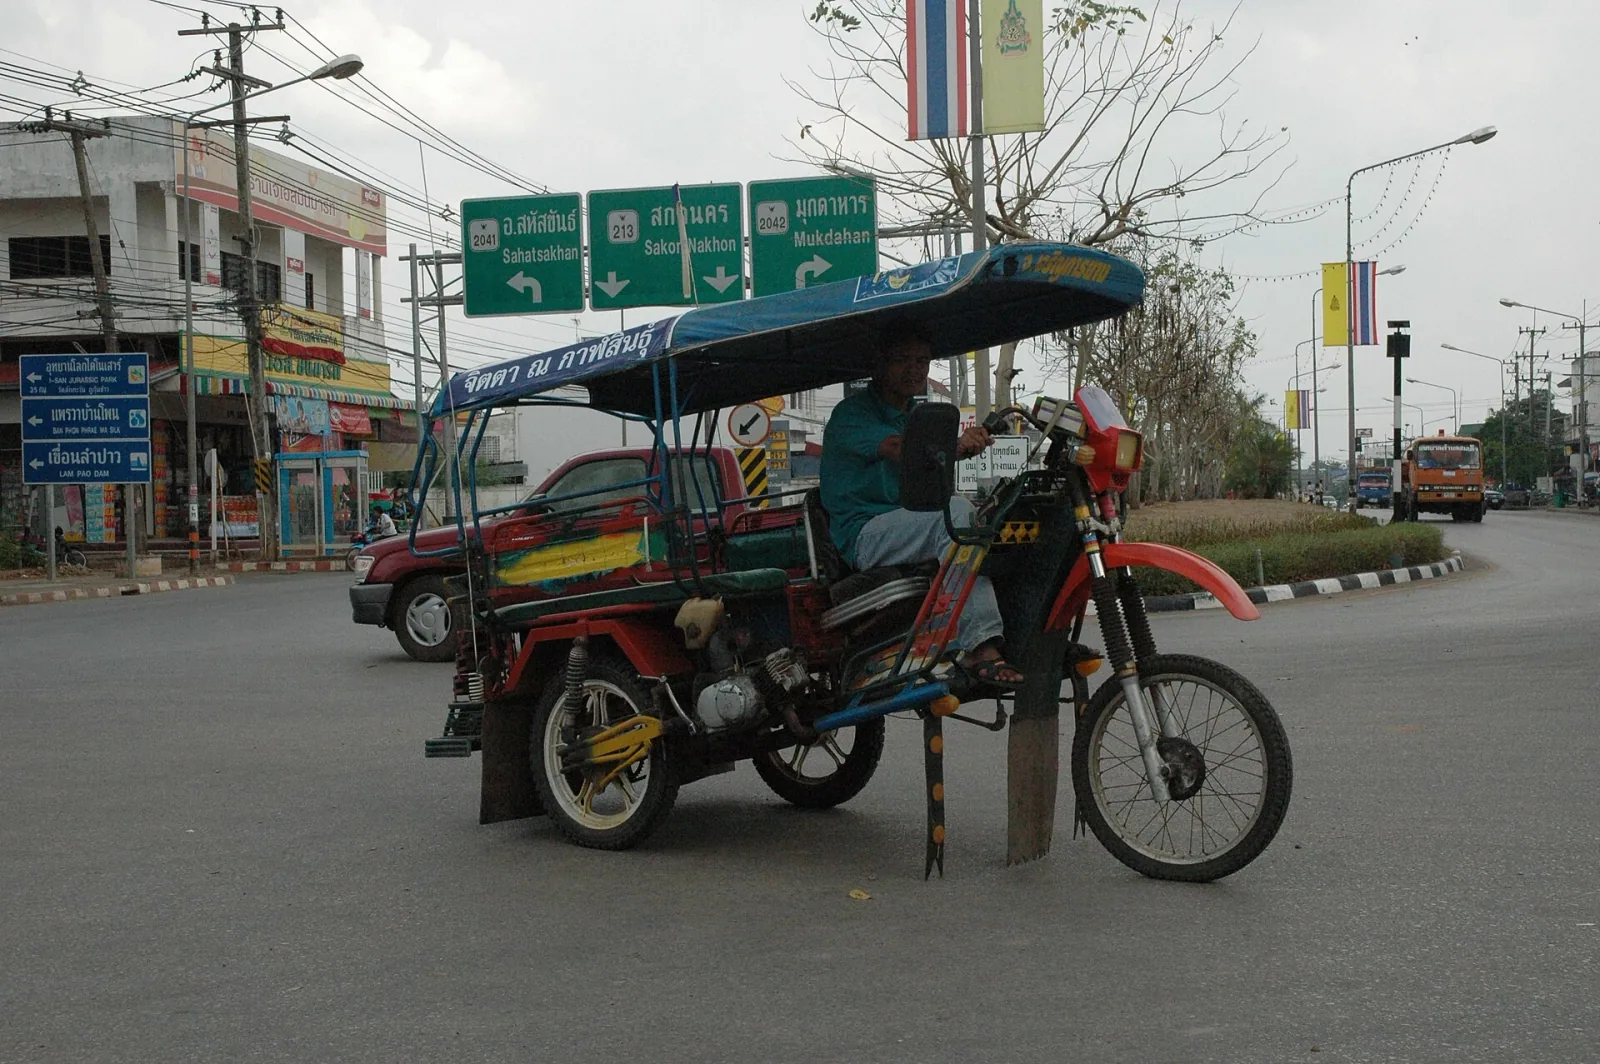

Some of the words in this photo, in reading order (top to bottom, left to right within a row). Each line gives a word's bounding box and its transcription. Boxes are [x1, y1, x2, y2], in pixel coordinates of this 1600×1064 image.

[796, 194, 867, 224] มุกดาหาร
[503, 209, 577, 236] อ.สหัสขันธ์
[759, 216, 787, 230] 2042
[473, 234, 497, 247] 2041
[612, 225, 635, 239] 213
[794, 229, 871, 248] Mukdahan
[502, 246, 579, 264] Sahatsakhan
[644, 239, 682, 256] Sakon
[687, 236, 736, 254] Nakhon
[46, 358, 122, 375] อุทยานโลกไดโนเสาร์
[464, 366, 519, 394] จิตตา
[526, 357, 553, 379] ณ
[557, 322, 656, 371] กาฬสินธุ์
[69, 376, 99, 384] JURASSIC
[51, 403, 120, 422] แพรวาบ้านโพน
[48, 443, 121, 465] เขื่อนลำปาว
[980, 462, 988, 472] 3
